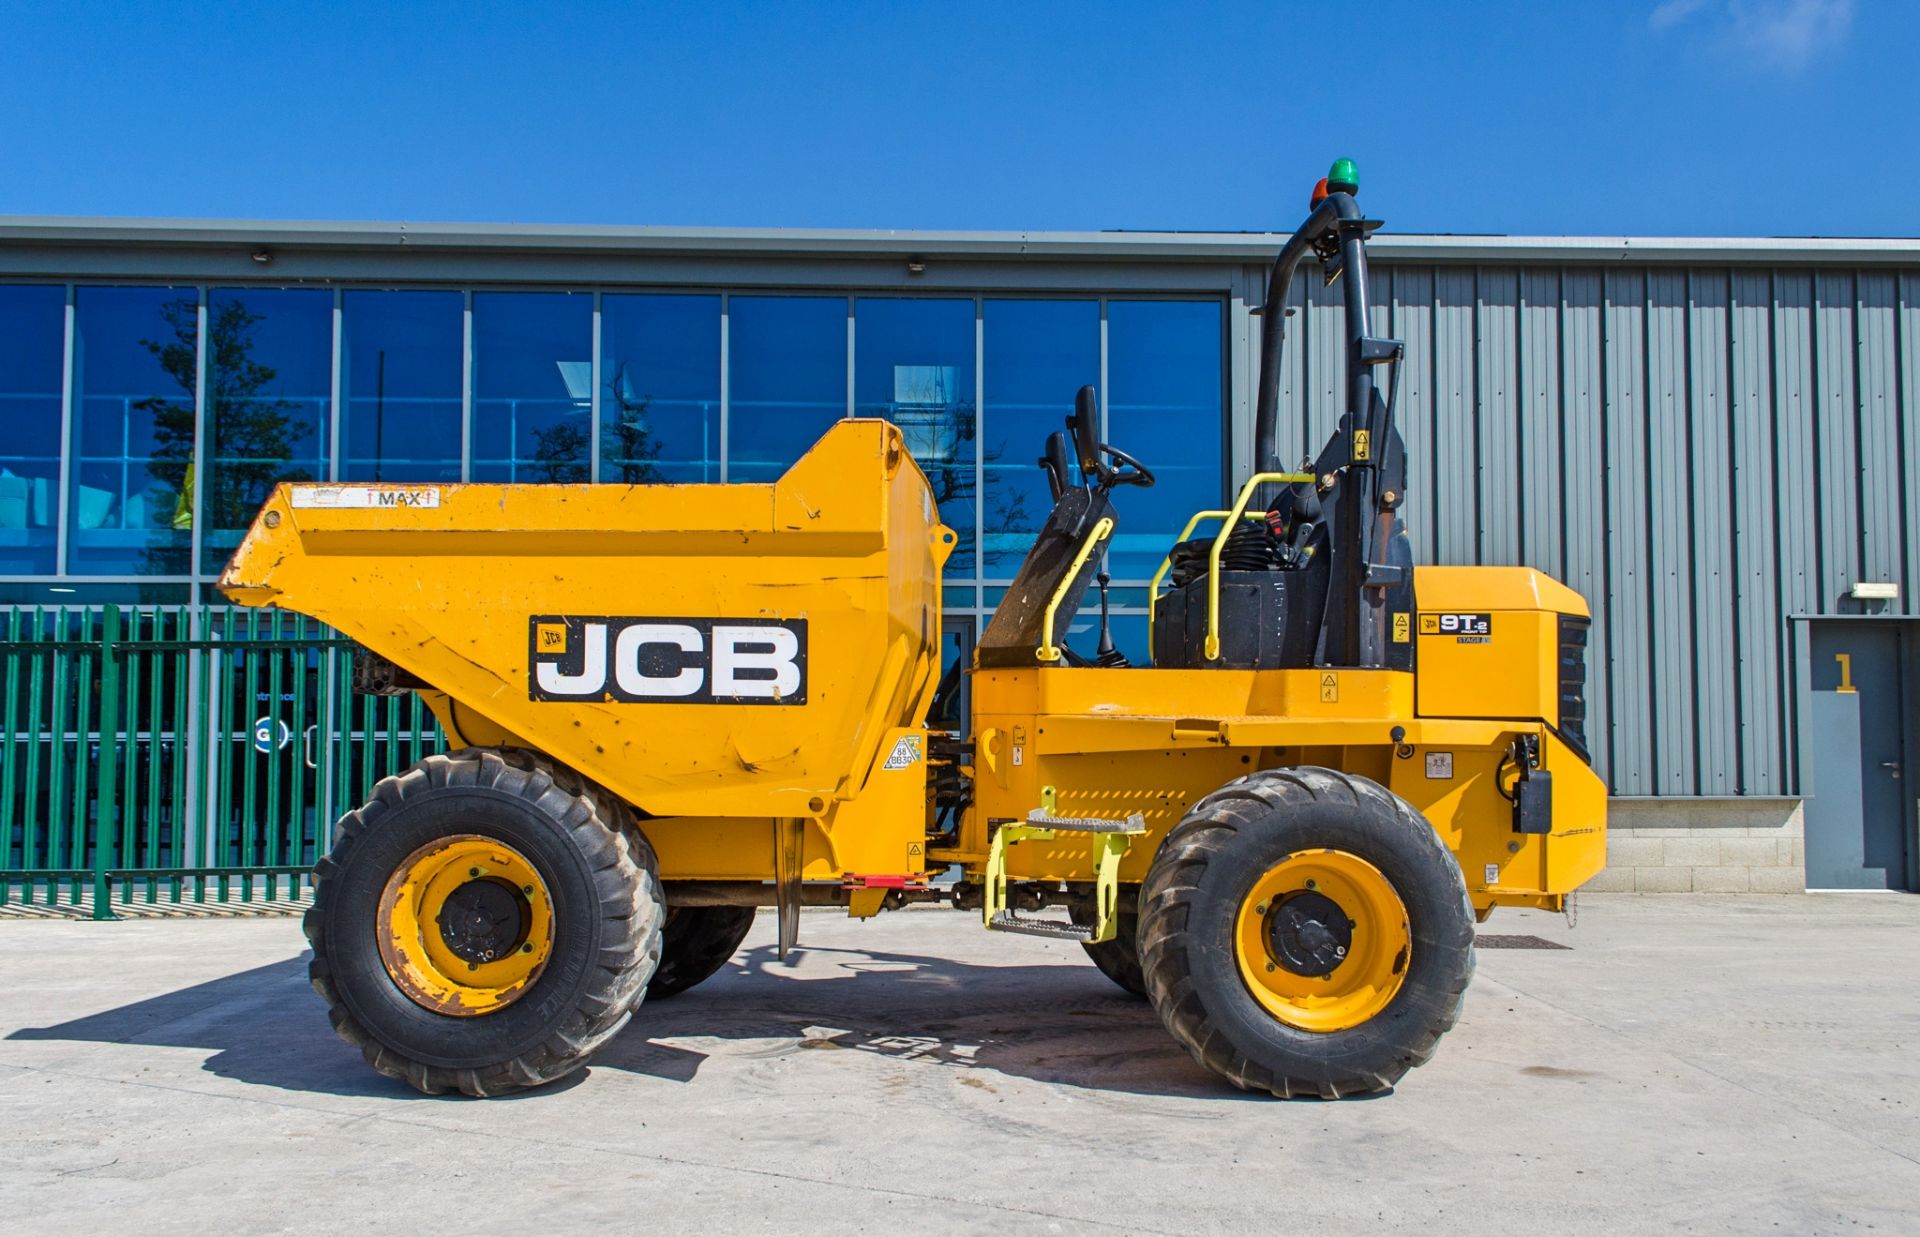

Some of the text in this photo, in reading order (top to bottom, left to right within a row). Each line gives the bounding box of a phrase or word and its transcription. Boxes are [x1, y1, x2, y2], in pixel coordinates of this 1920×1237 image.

[378, 491, 422, 506] MAX
[544, 631, 562, 645] JCB
[536, 623, 801, 697] JCB
[1835, 654, 1856, 693] 1
